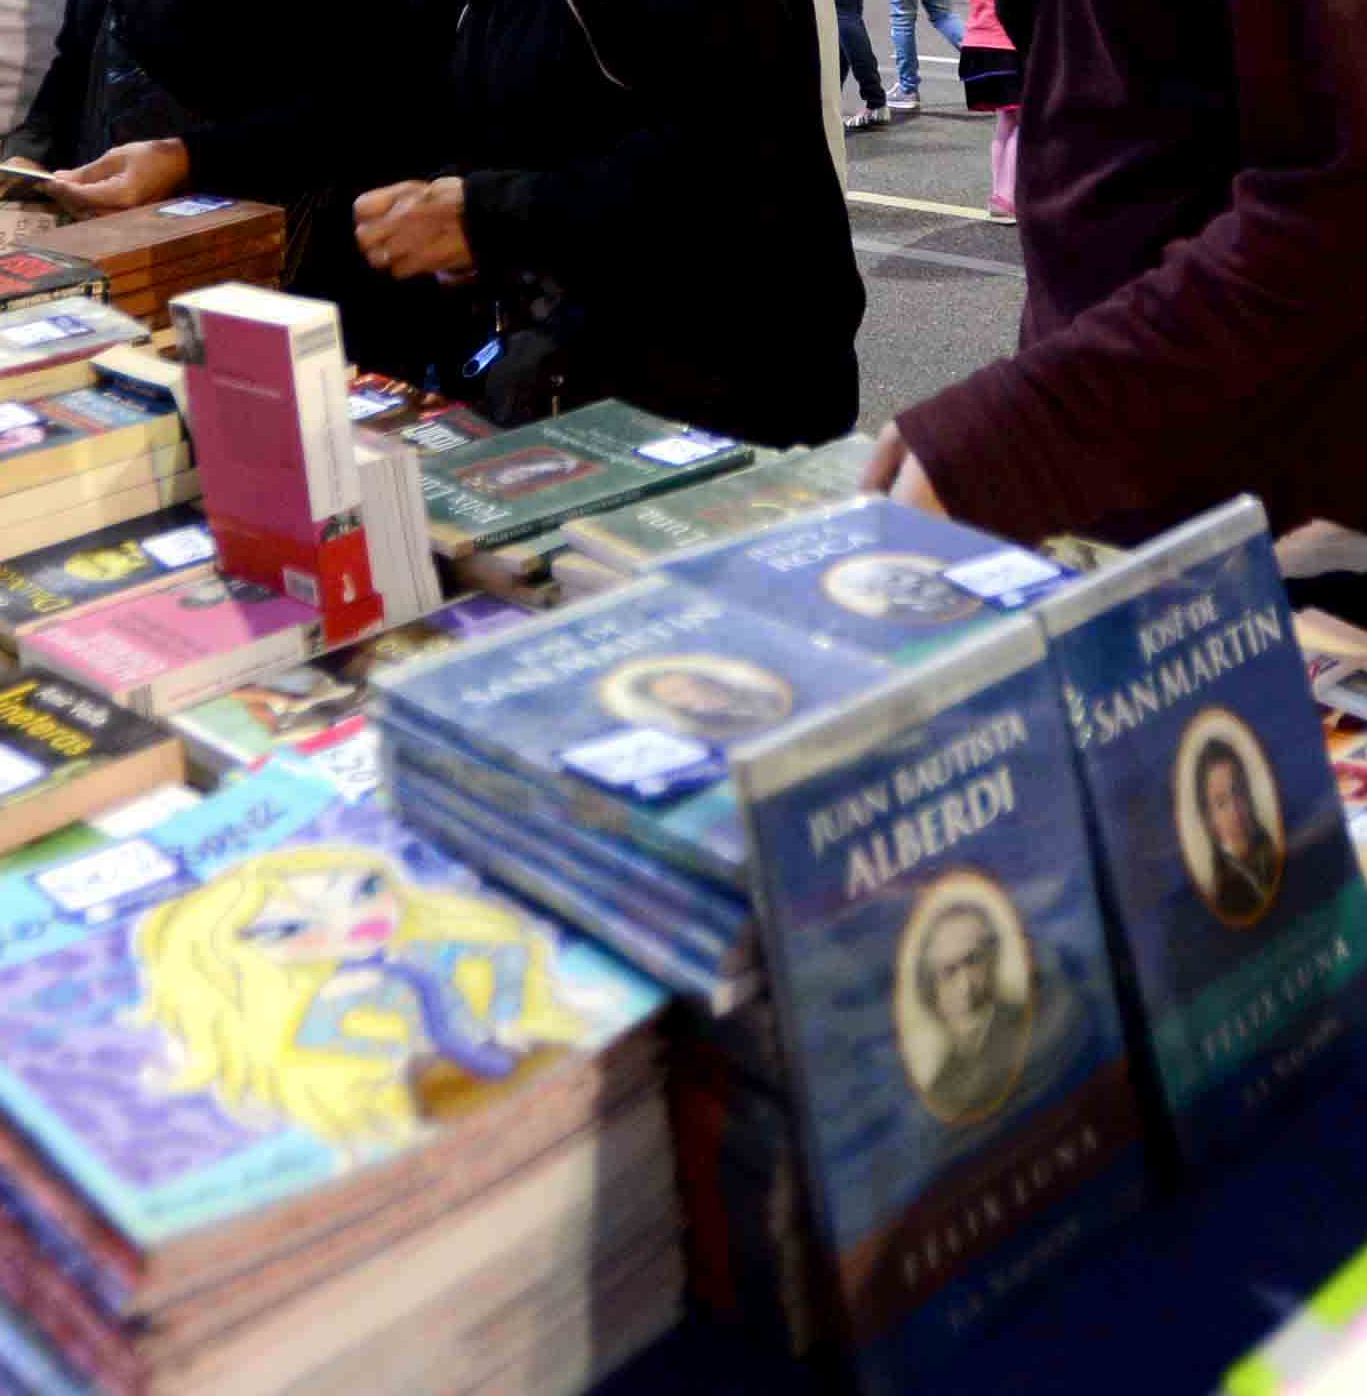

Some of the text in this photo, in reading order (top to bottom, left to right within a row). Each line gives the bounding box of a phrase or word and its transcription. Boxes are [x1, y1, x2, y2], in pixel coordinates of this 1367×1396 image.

[808, 709, 1030, 857] JUAN BAUTISTA
[847, 761, 1015, 900] ALBERDI
